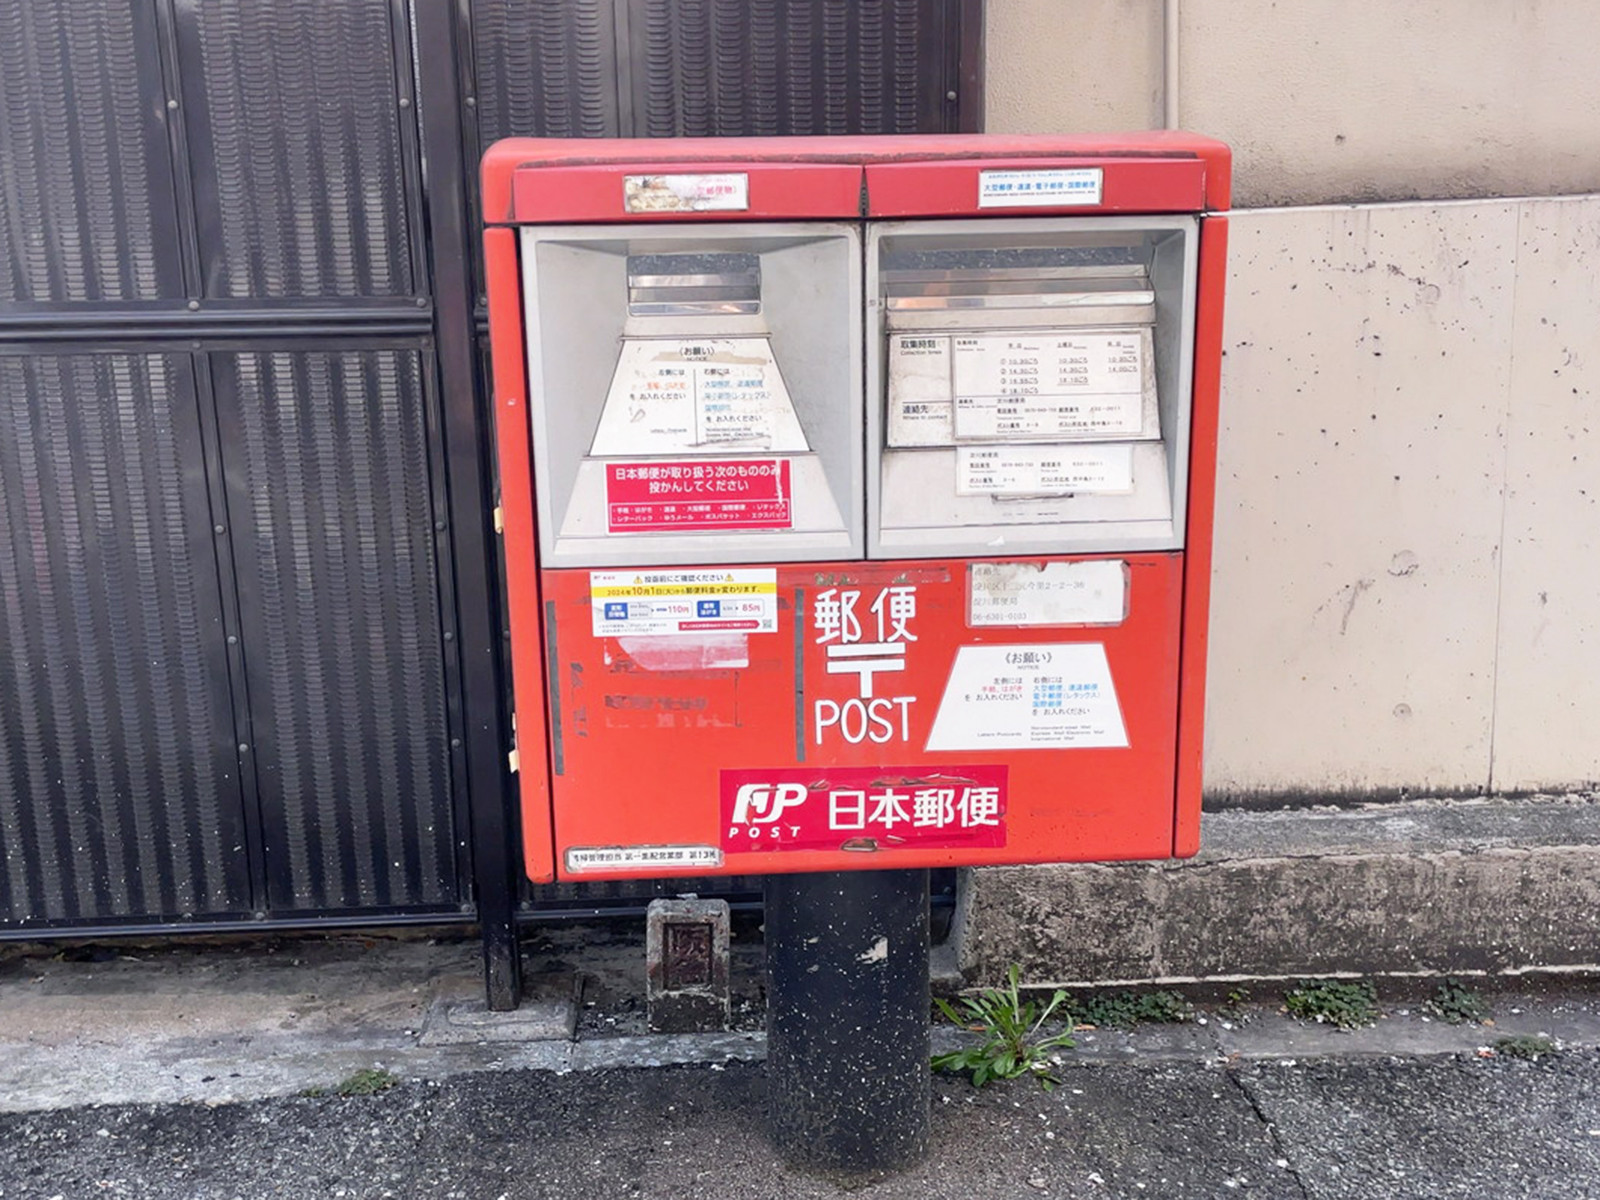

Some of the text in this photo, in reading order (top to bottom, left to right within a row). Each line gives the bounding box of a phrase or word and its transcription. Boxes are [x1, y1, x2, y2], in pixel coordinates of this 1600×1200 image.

[649, 480, 750, 494] 投かんしてください
[814, 586, 918, 644] 郵便
[993, 677, 1023, 685] 左側には
[1033, 676, 1063, 684] 右側には
[976, 693, 1023, 702] お入れください
[1043, 707, 1091, 716] お入れください
[815, 696, 917, 745] POST
[828, 786, 1000, 831] 日本郵便
[728, 826, 801, 838] POST
